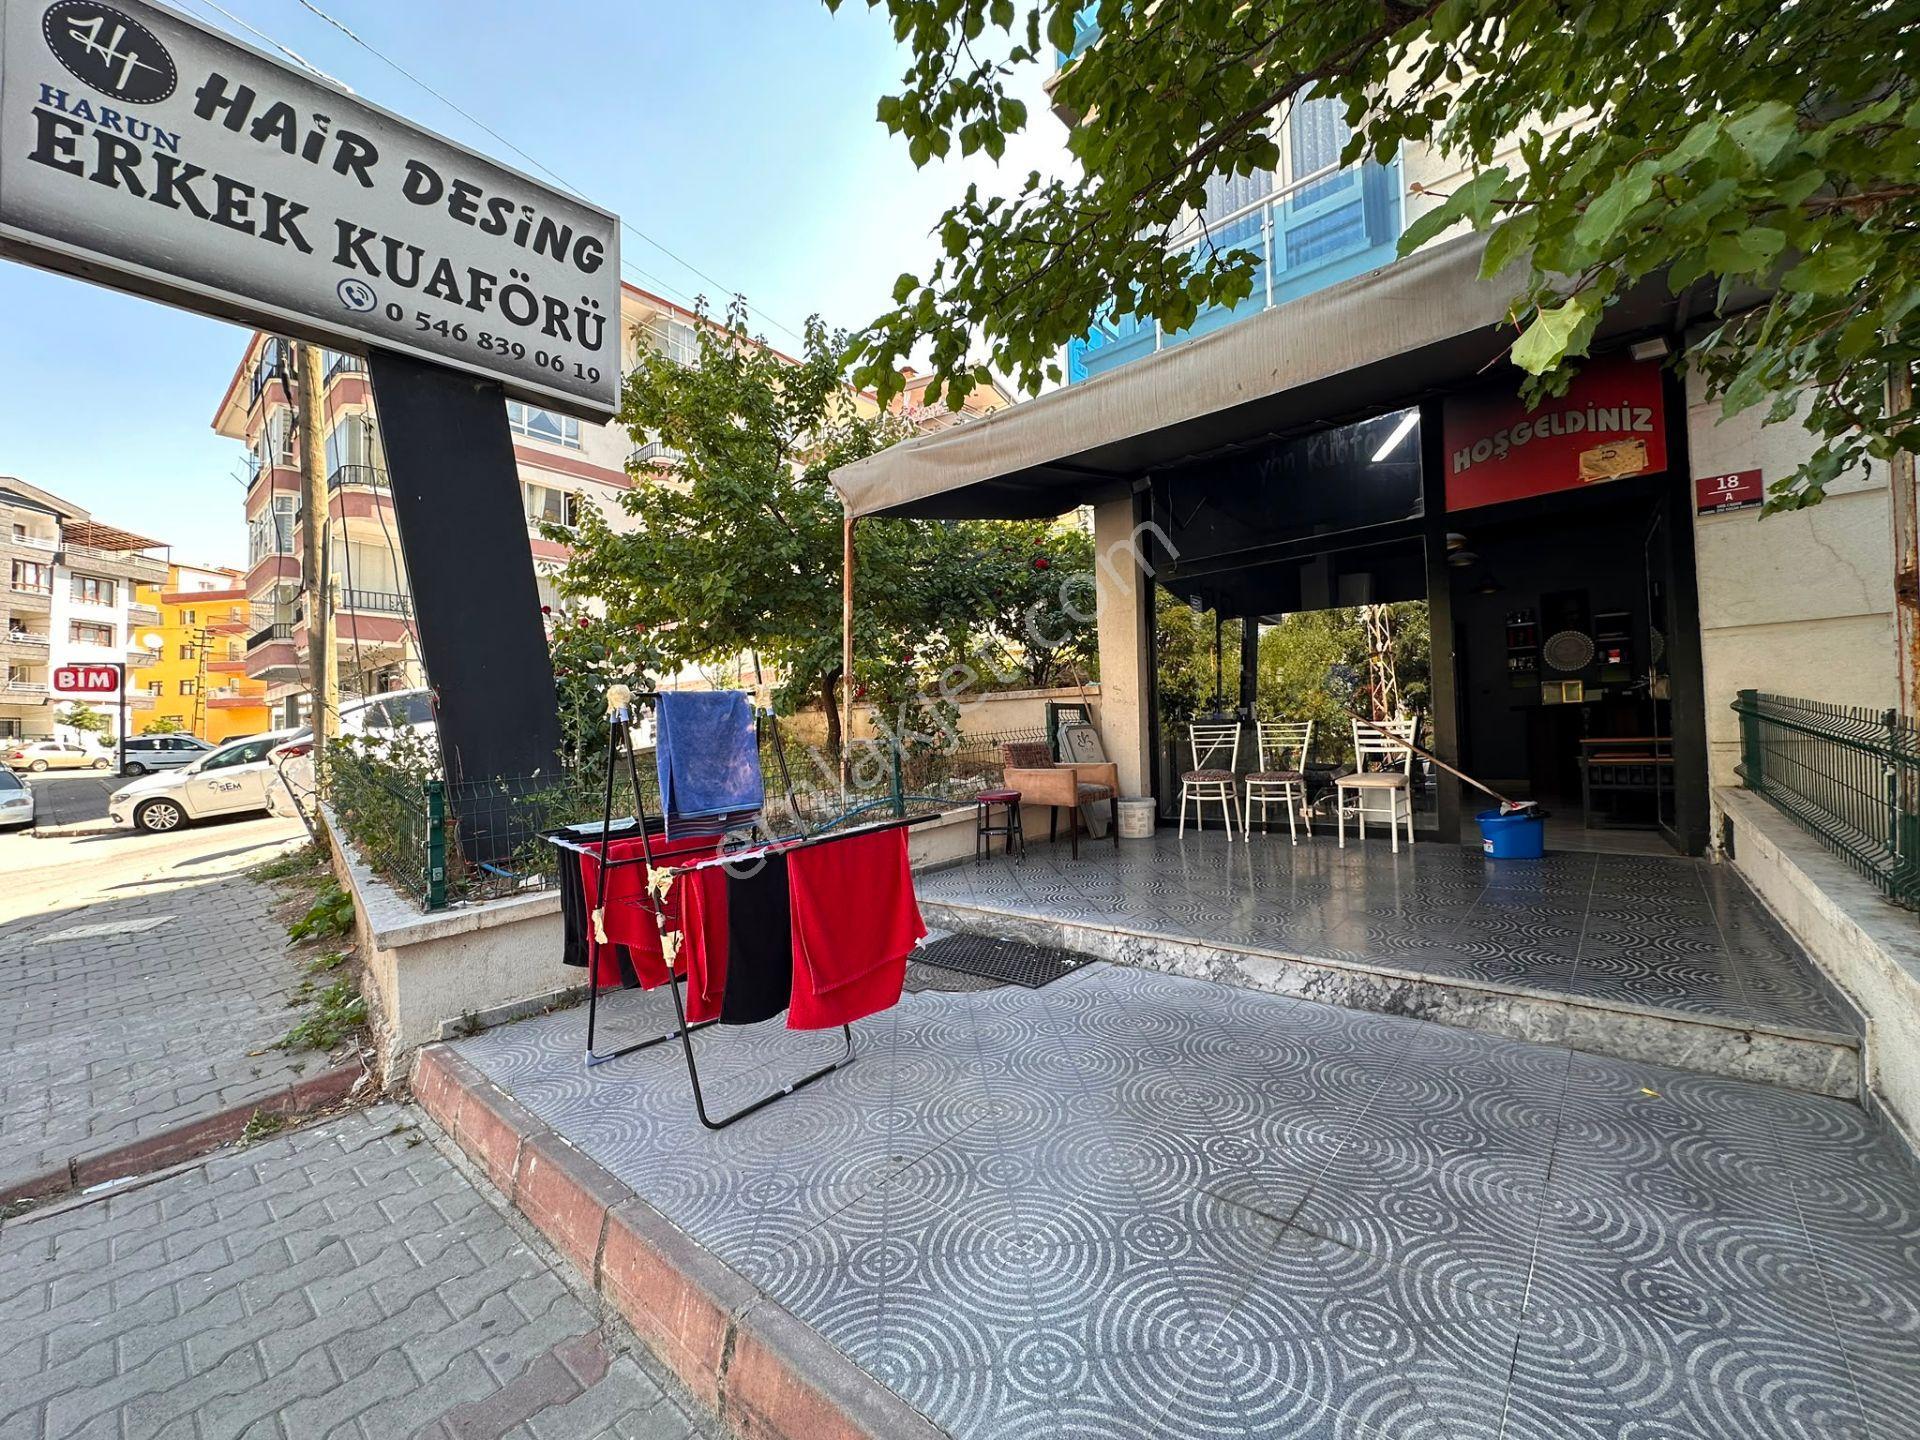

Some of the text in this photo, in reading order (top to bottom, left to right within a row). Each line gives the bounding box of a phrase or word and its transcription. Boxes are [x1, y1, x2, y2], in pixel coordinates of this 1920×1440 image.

[38, 83, 181, 153] HARUN
[27, 106, 606, 351] ERKEK KUAFÖRÜ
[385, 302, 601, 384] 0 546 839 06 19
[1717, 475, 1739, 490] 18
[1725, 492, 1733, 501] A
